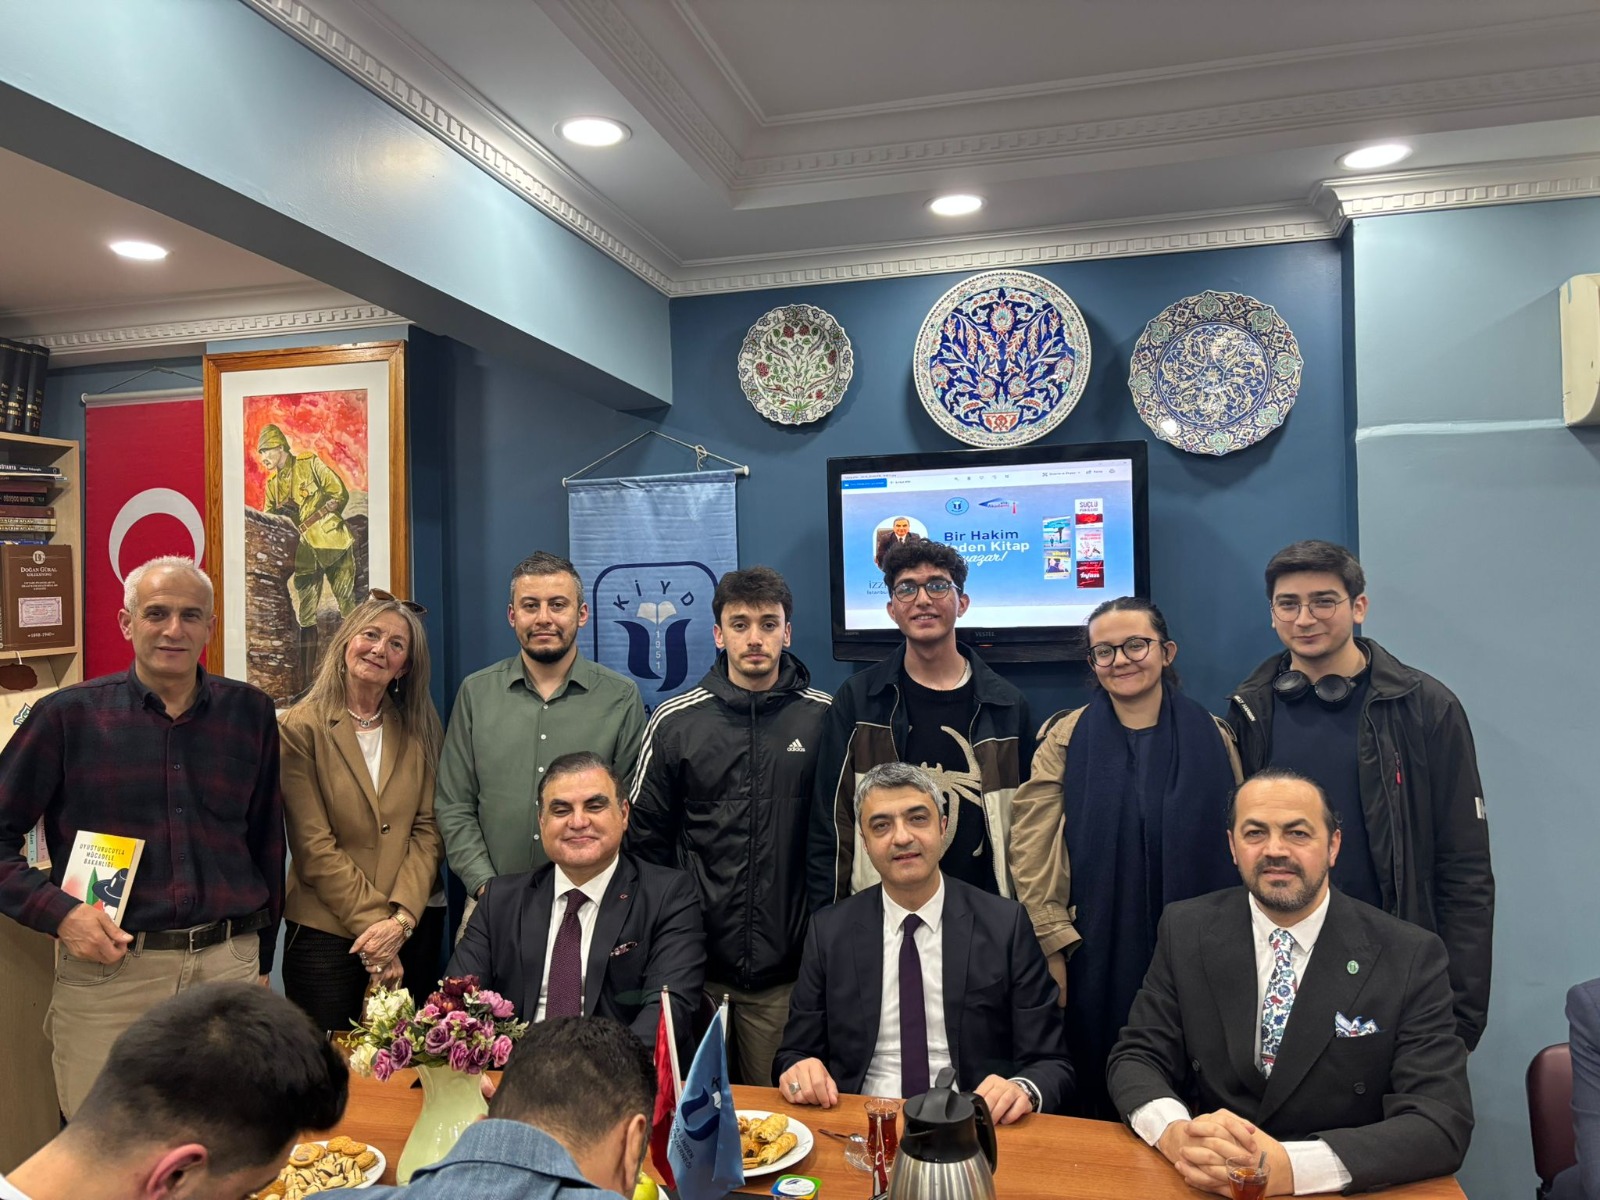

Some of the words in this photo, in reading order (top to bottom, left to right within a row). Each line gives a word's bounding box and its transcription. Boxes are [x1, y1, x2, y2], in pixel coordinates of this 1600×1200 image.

[1079, 501, 1099, 509] SUÇLU
[944, 532, 966, 541] Bir
[971, 529, 1019, 540] Hakim
[990, 541, 1030, 553] Kitap
[613, 580, 695, 611] KİYD
